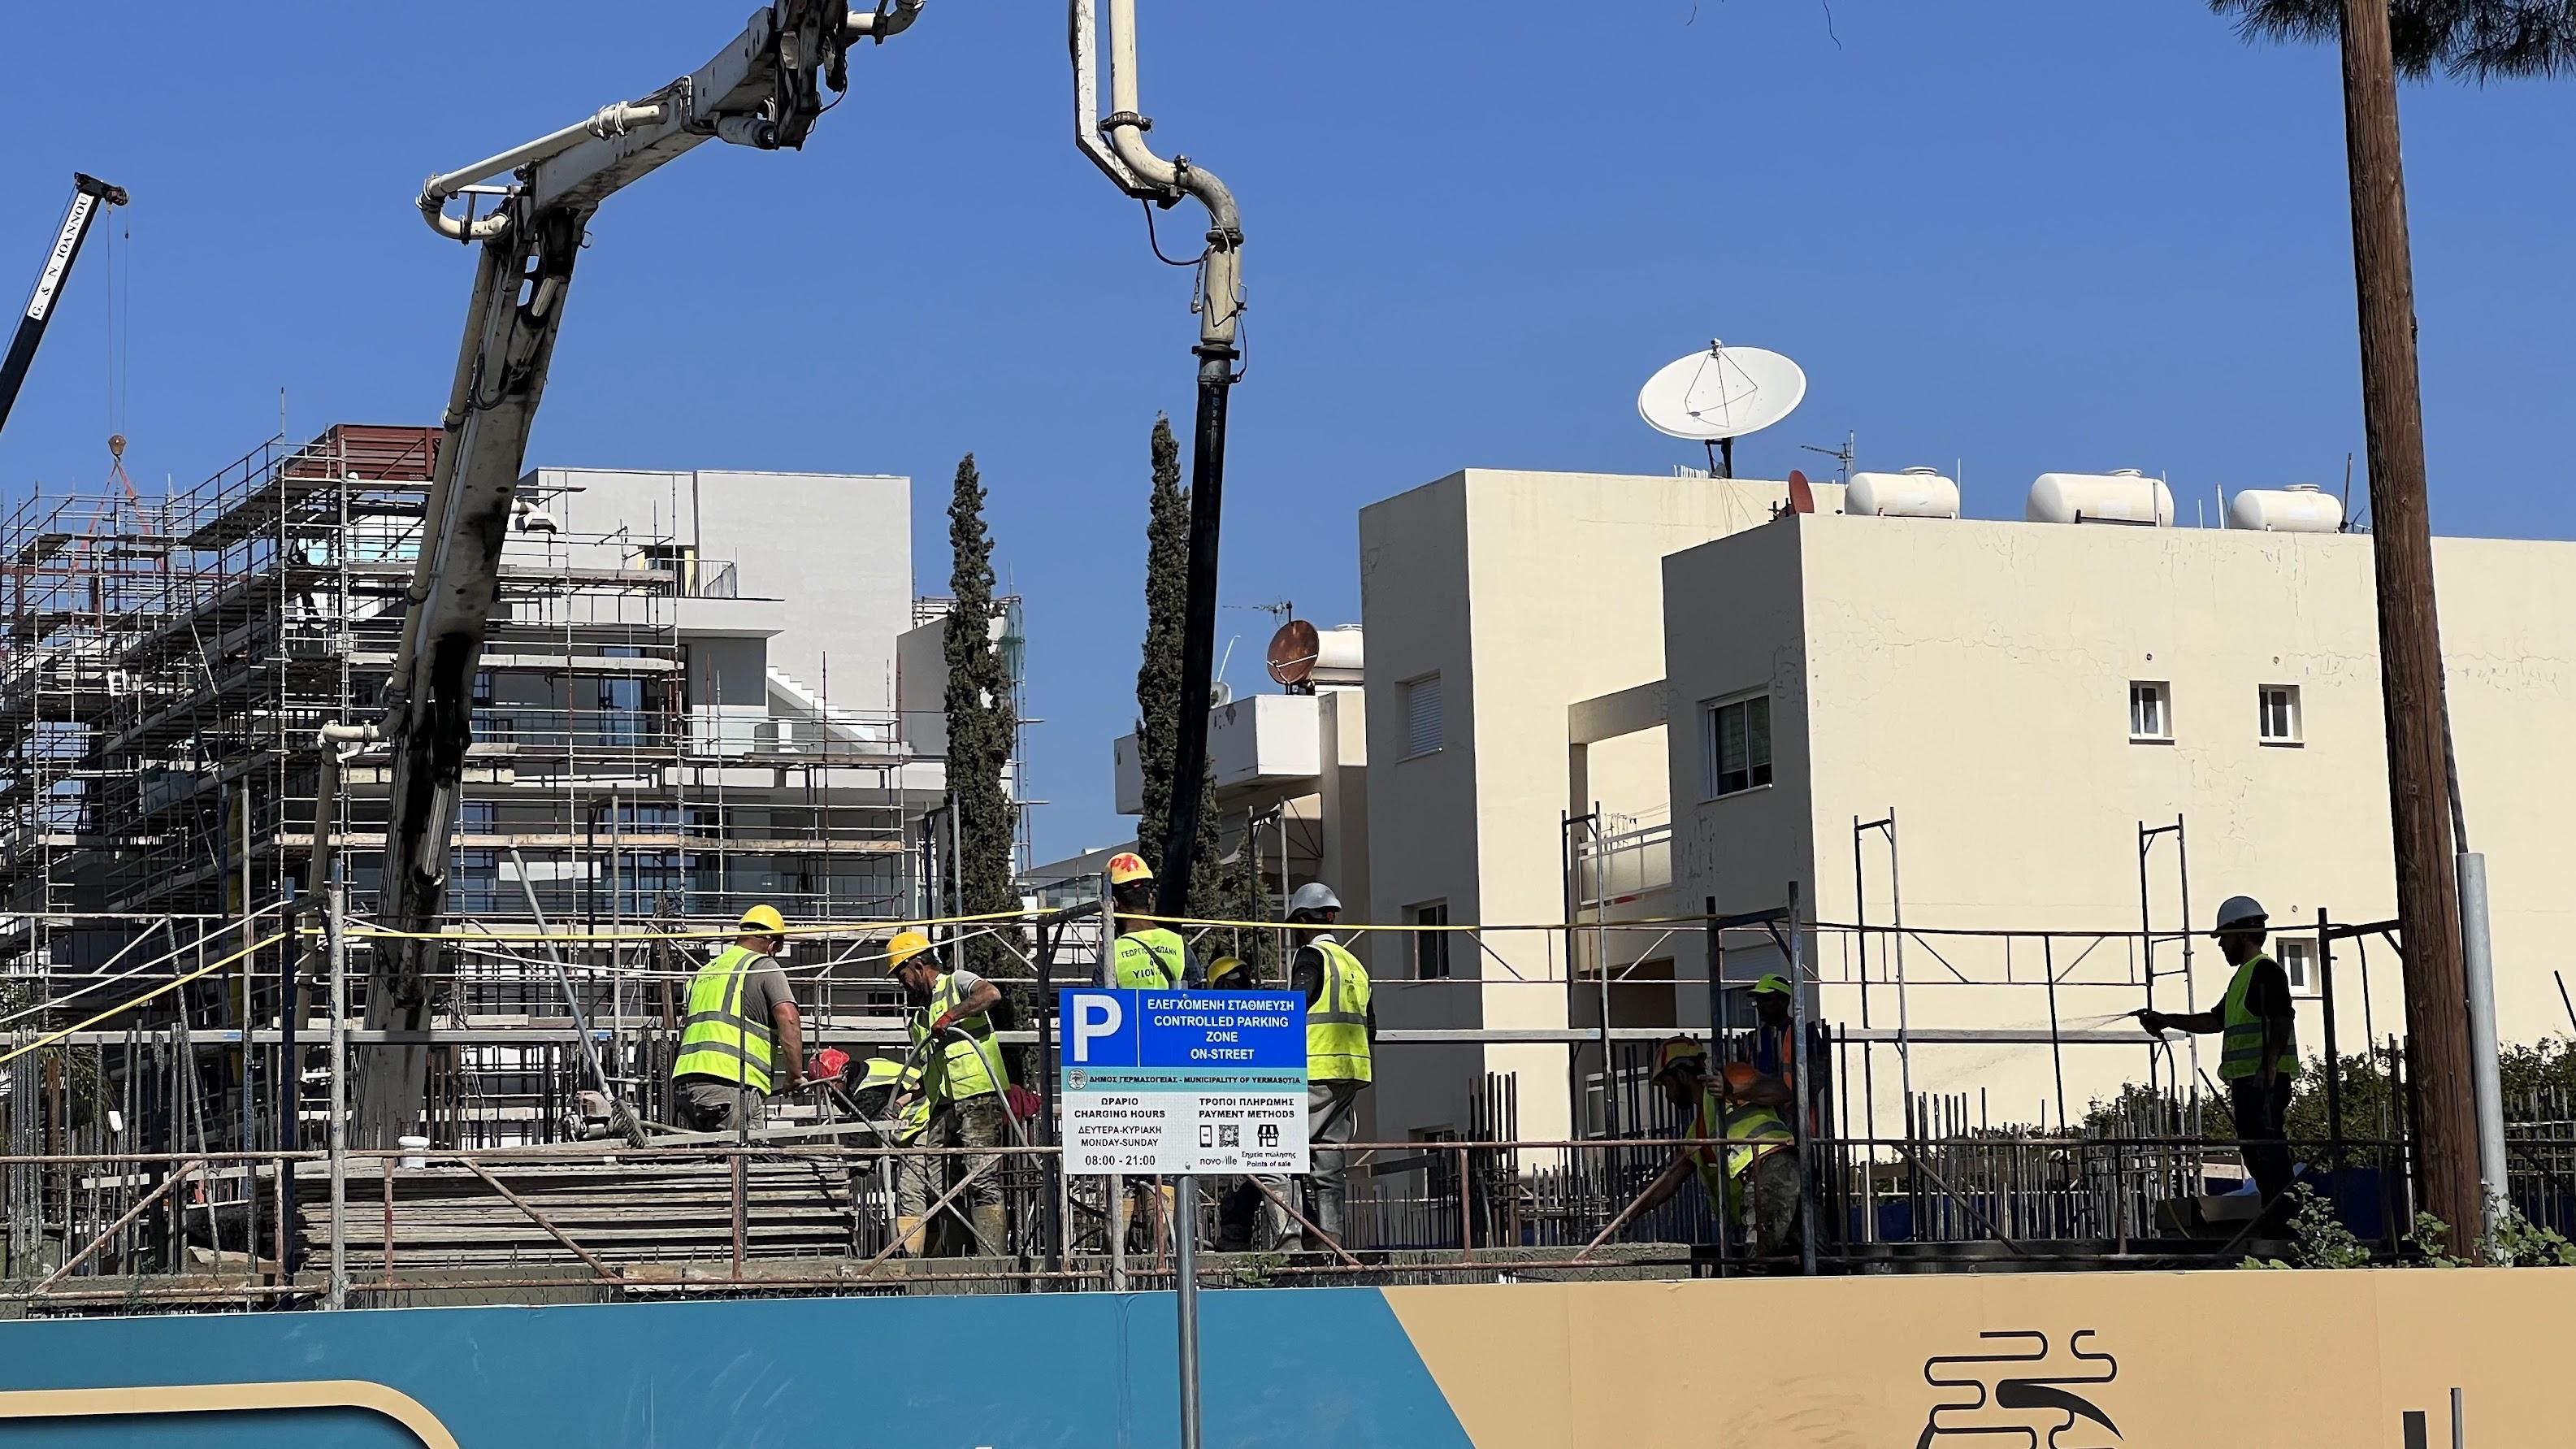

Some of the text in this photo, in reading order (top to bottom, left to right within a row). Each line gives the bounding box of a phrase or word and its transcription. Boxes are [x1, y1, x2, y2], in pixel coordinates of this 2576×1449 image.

[32, 196, 89, 316] G. & N. IOANNOU
[1147, 999, 1295, 1011] ΕΛΕΓΧΟΜΕΝΗ ΣΤΑΘΜΕΥΣΗ
[1154, 1015, 1289, 1027] CONTROLLED PARKING
[1073, 994, 1123, 1062] P
[1206, 1031, 1238, 1042] ZONE
[1190, 1048, 1255, 1060] ON-STREET
[1101, 1097, 1138, 1105] ΩΡΑΡΙΟ
[1199, 1098, 1295, 1106] ΤΡΟΠΟΙ ΠΛΗΡΩΜΗΣ
[1074, 1110, 1165, 1118] CHARGING HOURS
[1199, 1110, 1295, 1118] PAYMENT METHODS
[1078, 1126, 1162, 1134] ΔΕΥΤΕΡΑ-ΚΥΡΙΑΚΗ
[1081, 1139, 1159, 1147] MONDAY-SUNDAY
[1085, 1155, 1115, 1165] 08:00
[1125, 1155, 1156, 1165] 21:00
